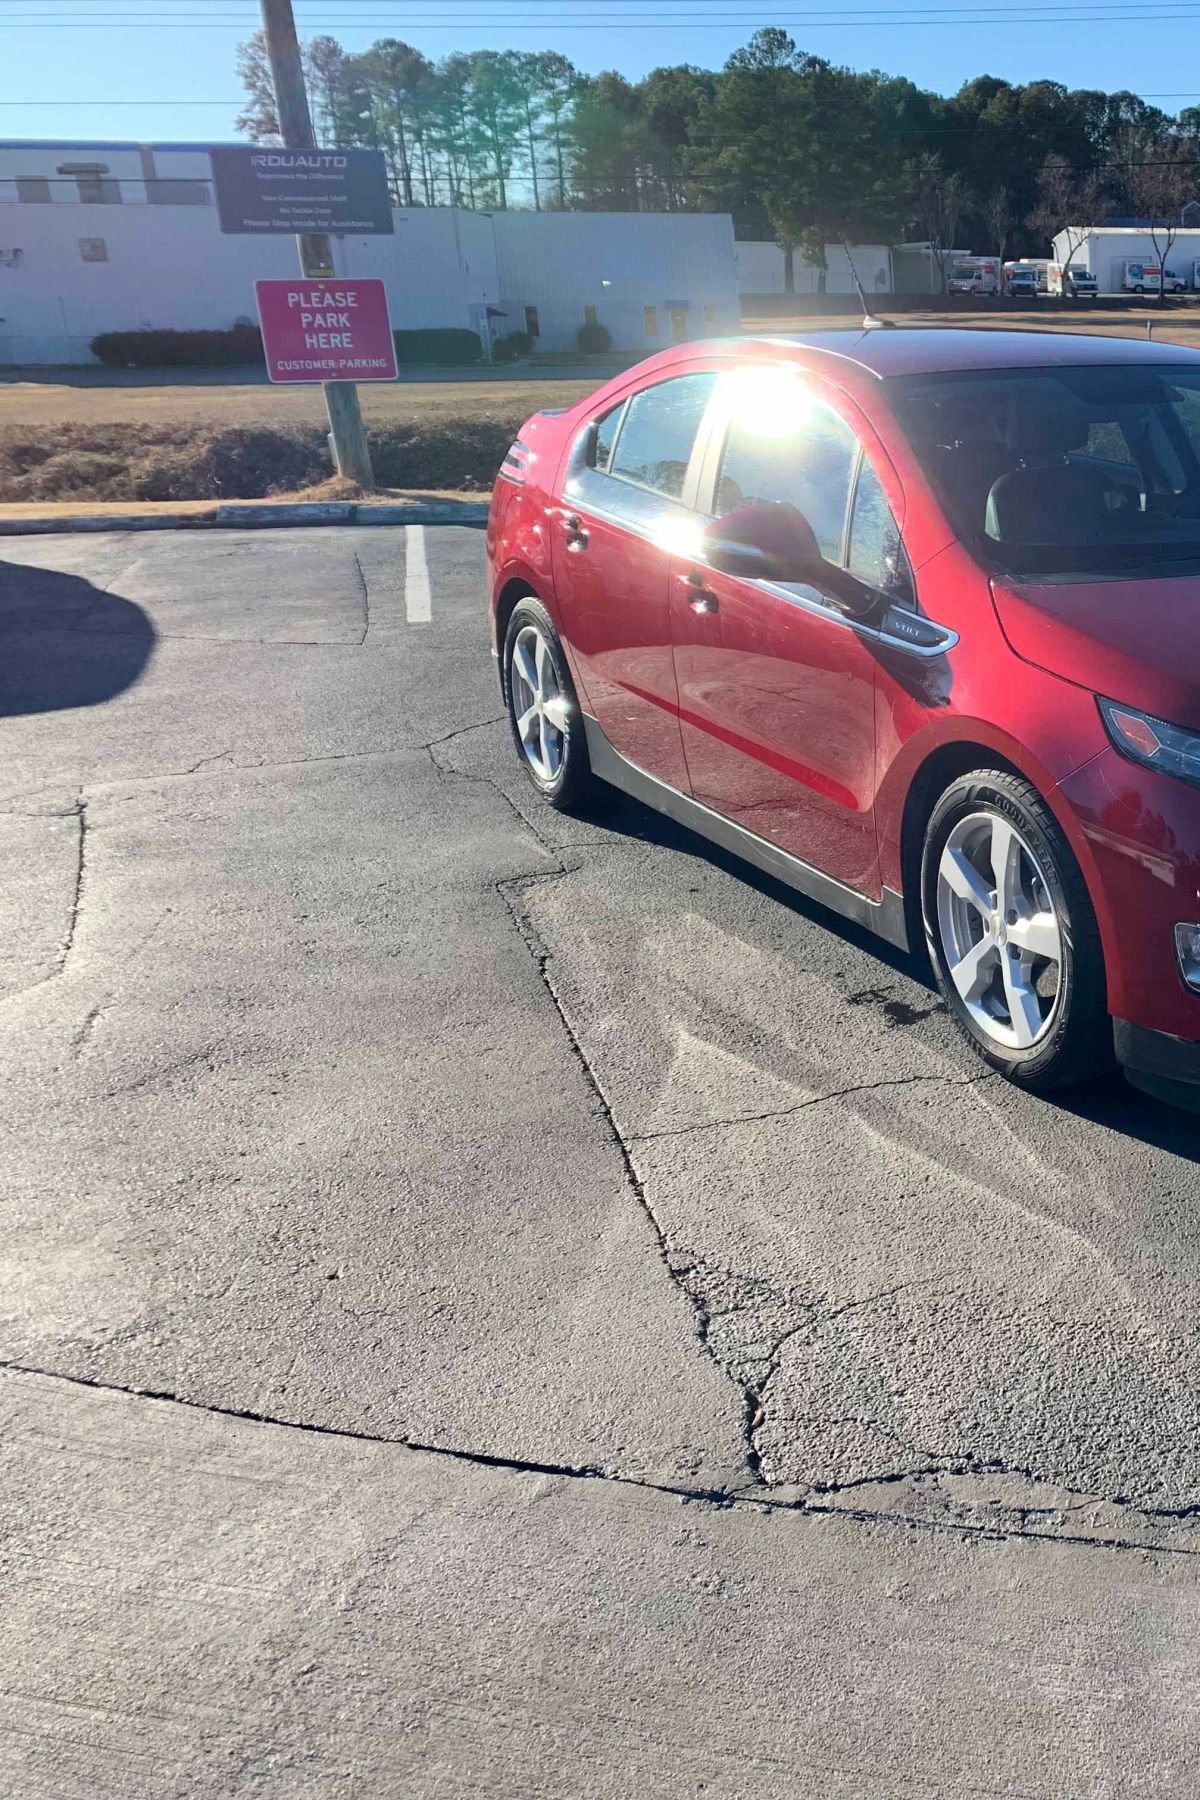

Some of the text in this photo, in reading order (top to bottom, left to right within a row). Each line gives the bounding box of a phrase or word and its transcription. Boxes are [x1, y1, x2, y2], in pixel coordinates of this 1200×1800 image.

[287, 291, 358, 308] PLEASE
[301, 312, 351, 328] PARK
[304, 333, 353, 349] HERE
[277, 358, 387, 370] CUSTOMER PARKING
